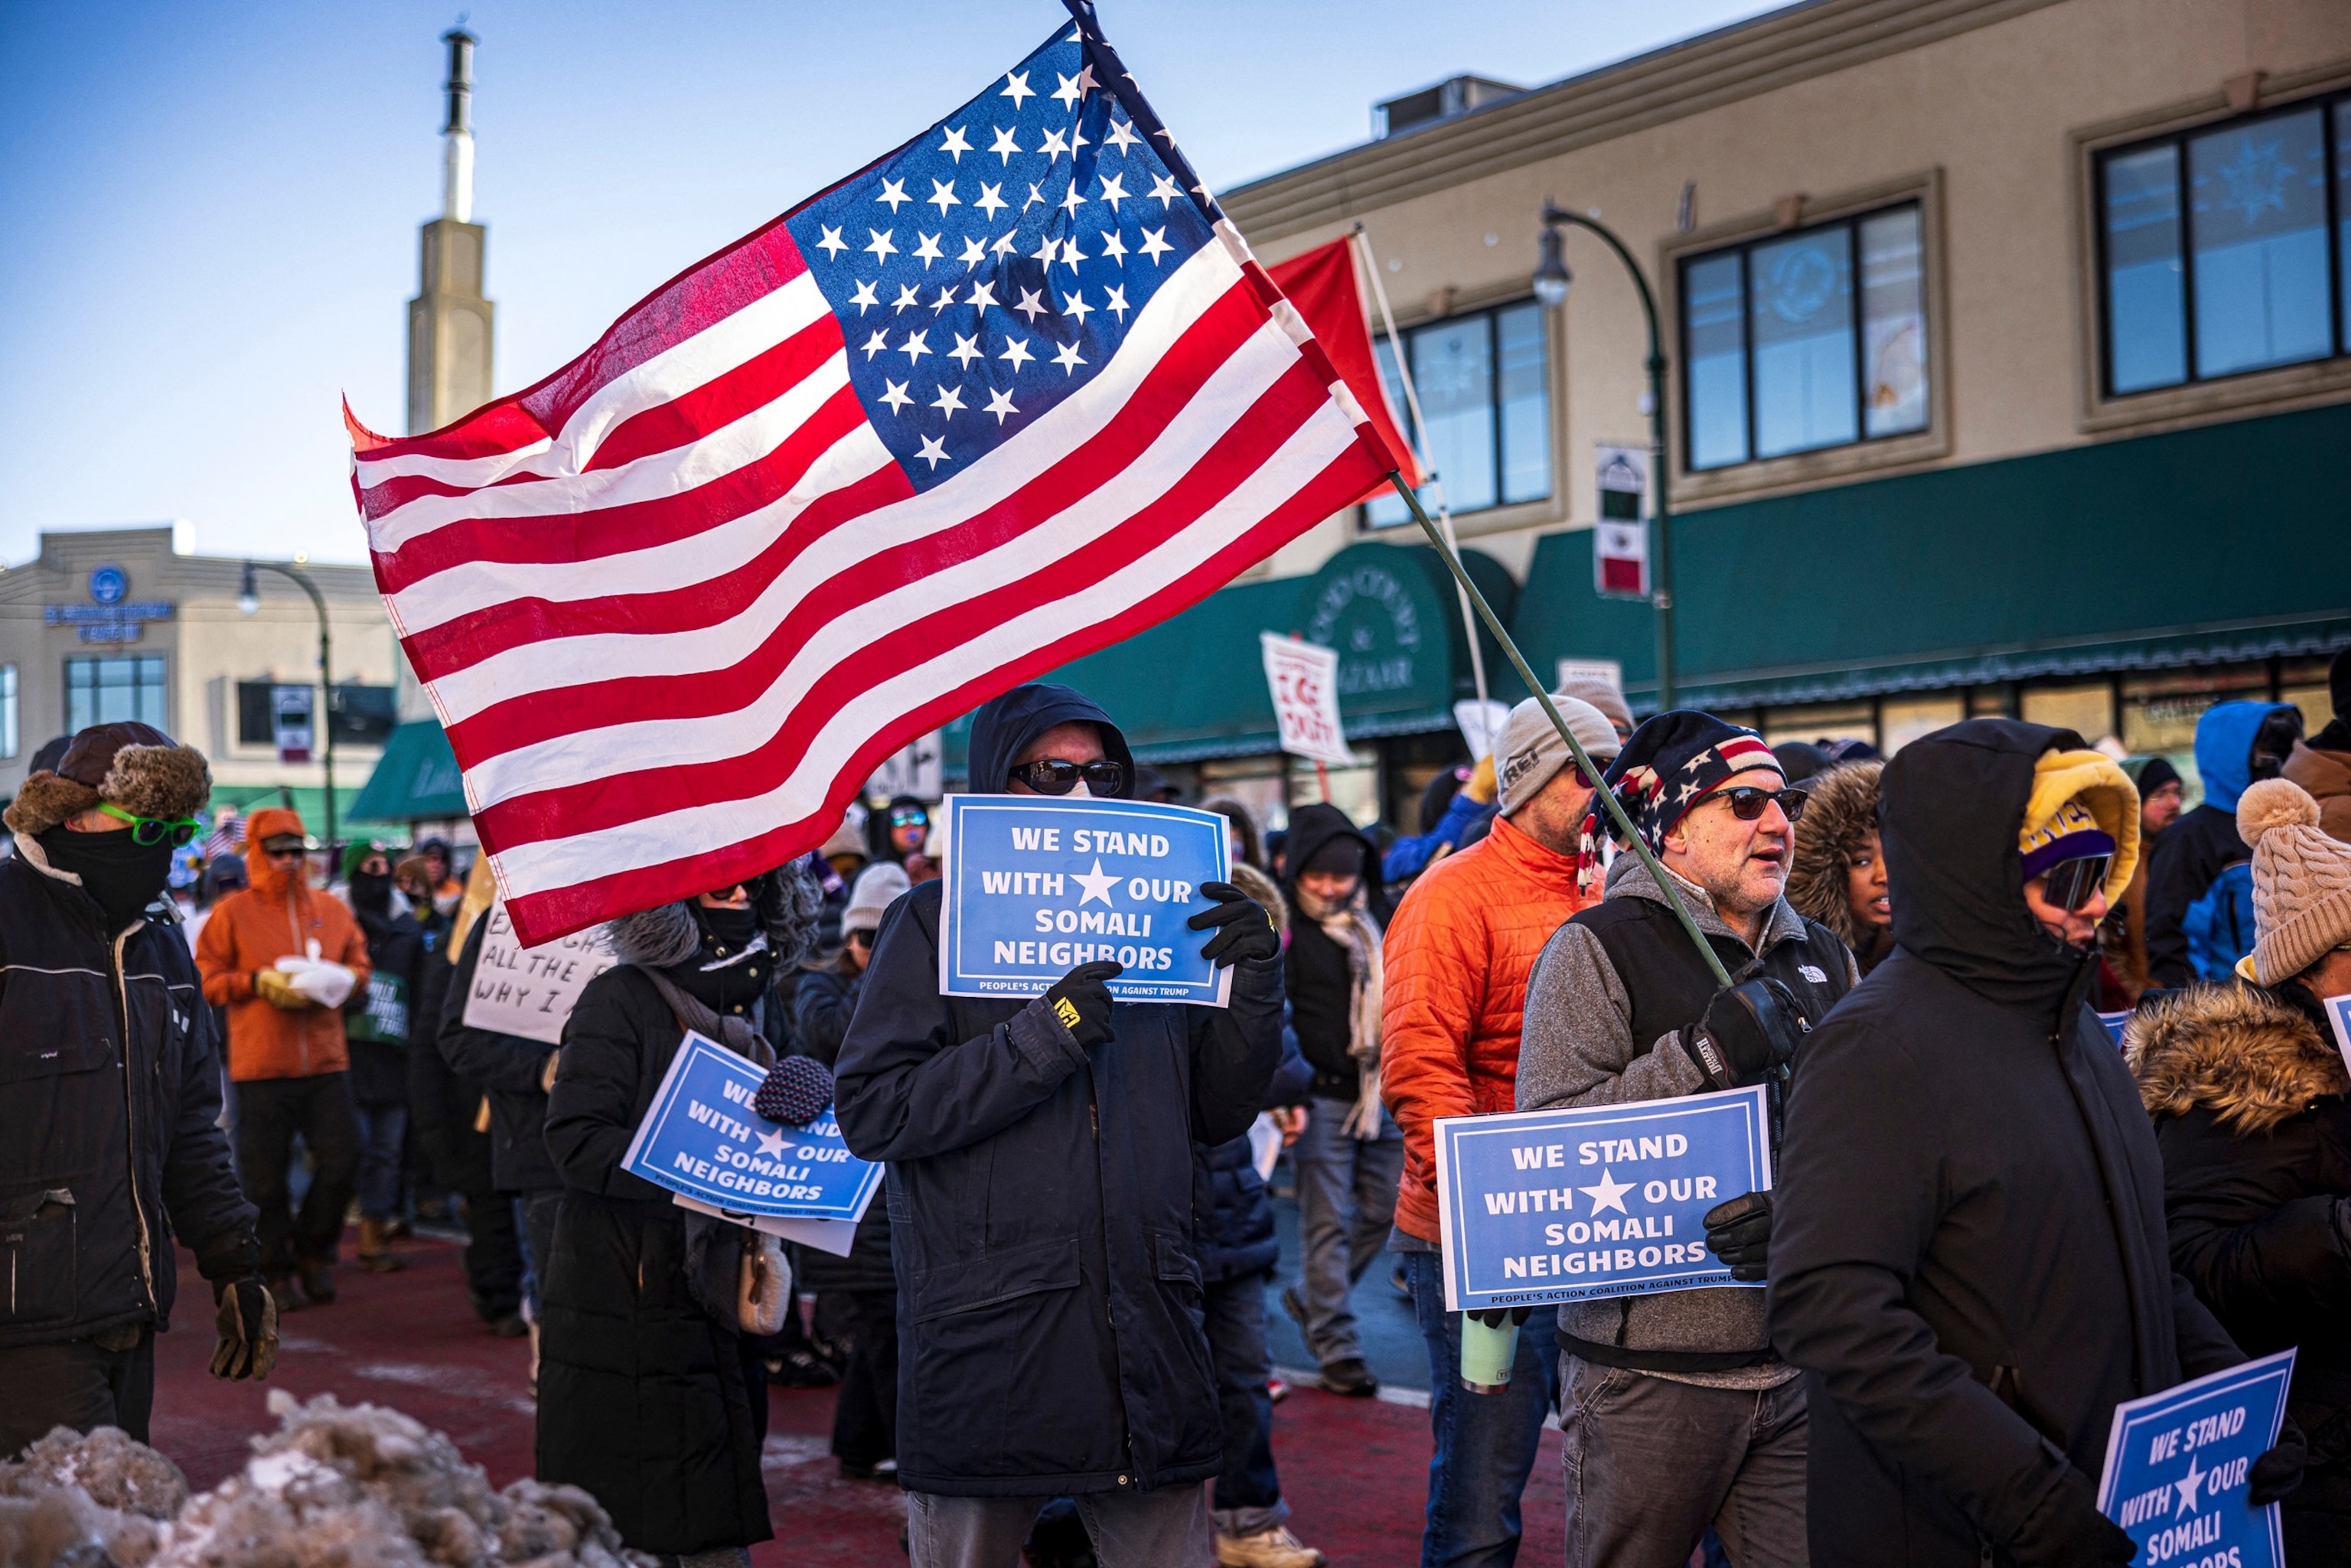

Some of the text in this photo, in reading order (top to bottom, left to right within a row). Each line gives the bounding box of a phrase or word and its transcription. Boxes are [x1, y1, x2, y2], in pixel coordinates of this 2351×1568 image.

[1011, 827, 1170, 857] WE STAND
[981, 871, 1192, 904] WITH OUR
[1035, 909, 1152, 937] SOMALI
[482, 945, 518, 970] ALL
[527, 954, 579, 983] THE
[994, 940, 1173, 970] NEIGHBORS
[474, 980, 530, 1008] WHY
[538, 989, 561, 1012] I
[980, 981, 1029, 991] PEOPLE'S
[1121, 986, 1158, 996] AGAINST
[1159, 987, 1190, 996] TRUMP
[1696, 1037, 1723, 1075] DULUTH
[687, 1100, 852, 1163] WITH OUR
[714, 1145, 810, 1181] SOMALI
[1511, 1133, 1688, 1170] WE STAND
[673, 1152, 823, 1201] NEIGHBORS
[1484, 1175, 1717, 1215] WITH OUR
[1545, 1215, 1674, 1246] SOMALI
[1503, 1240, 1706, 1279] NEIGHBORS
[1492, 1275, 1733, 1304] PEOPLE'S ACTION COALITION AGAINST TRUMP
[2148, 1406, 2246, 1465] WE STAND
[2119, 1456, 2248, 1529] WITH OUR
[2147, 1510, 2221, 1566] SOMALI
